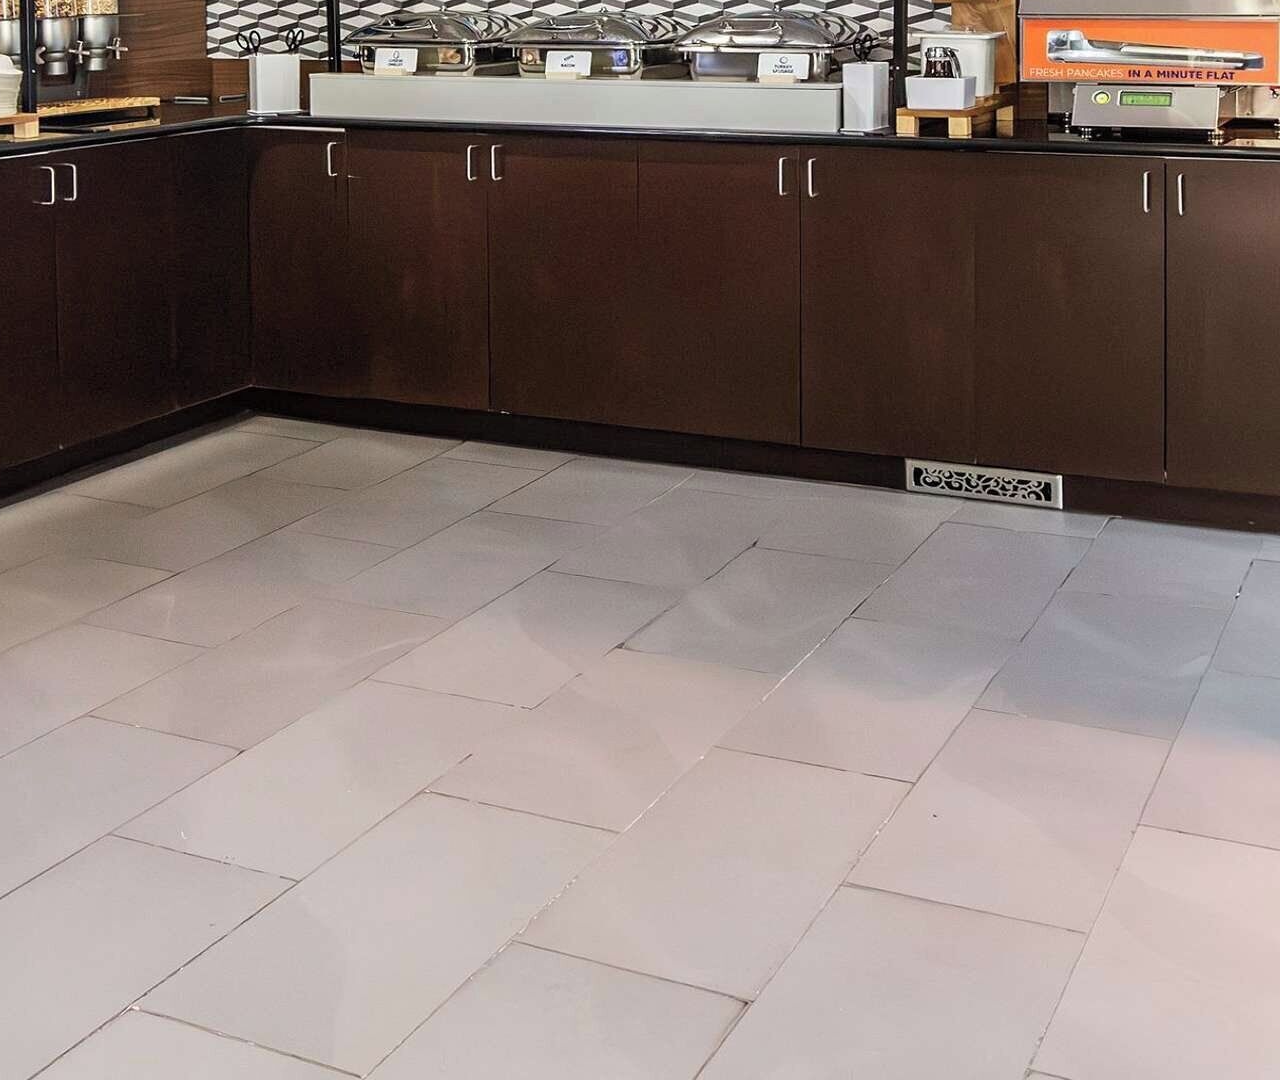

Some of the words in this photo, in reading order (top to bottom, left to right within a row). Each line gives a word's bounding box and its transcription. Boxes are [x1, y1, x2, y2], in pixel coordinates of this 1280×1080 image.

[1029, 67, 1063, 78] FRESH
[1066, 68, 1125, 79] PANCAKES
[1127, 69, 1141, 78] IN
[1144, 69, 1153, 78] A
[1156, 69, 1203, 80] MINUTE
[1206, 70, 1236, 81] FLAT
